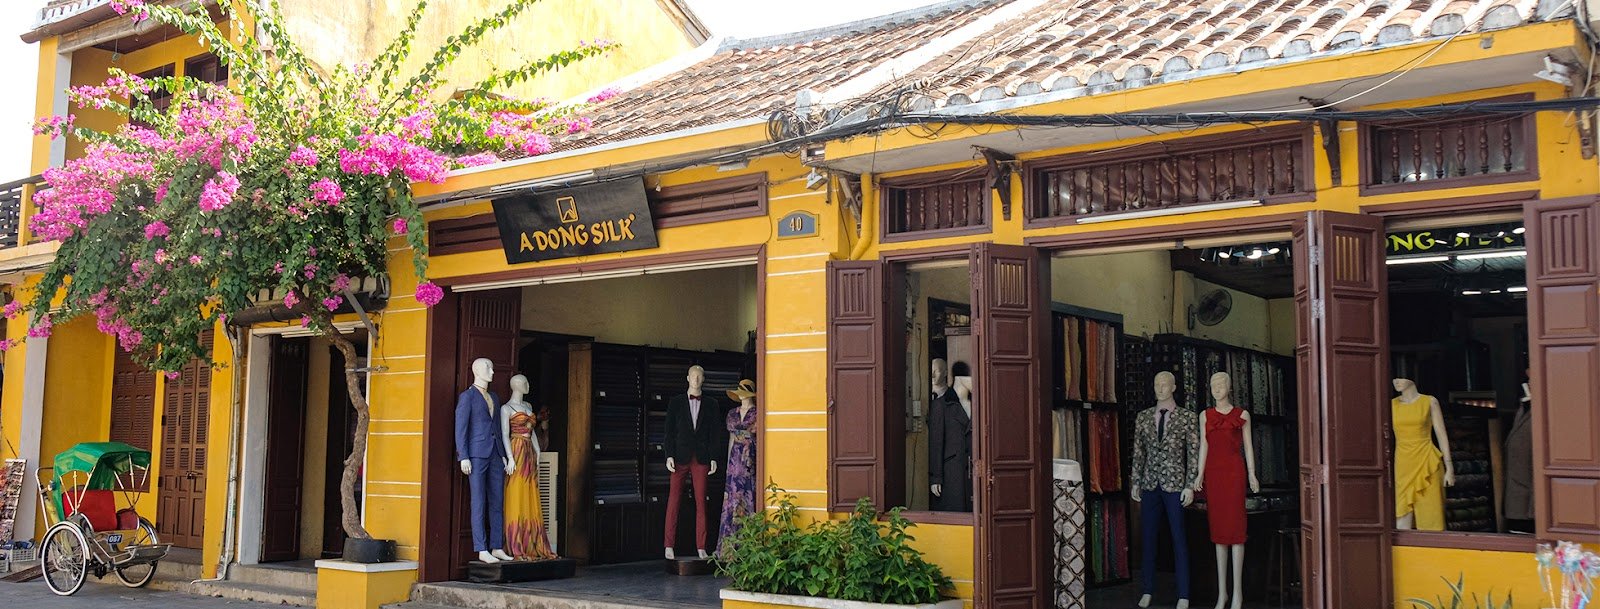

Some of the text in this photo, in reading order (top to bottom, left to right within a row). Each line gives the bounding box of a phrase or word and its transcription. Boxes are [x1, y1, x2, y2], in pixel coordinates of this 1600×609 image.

[790, 216, 802, 232] 40
[520, 232, 534, 253] A
[532, 224, 589, 250] DONG
